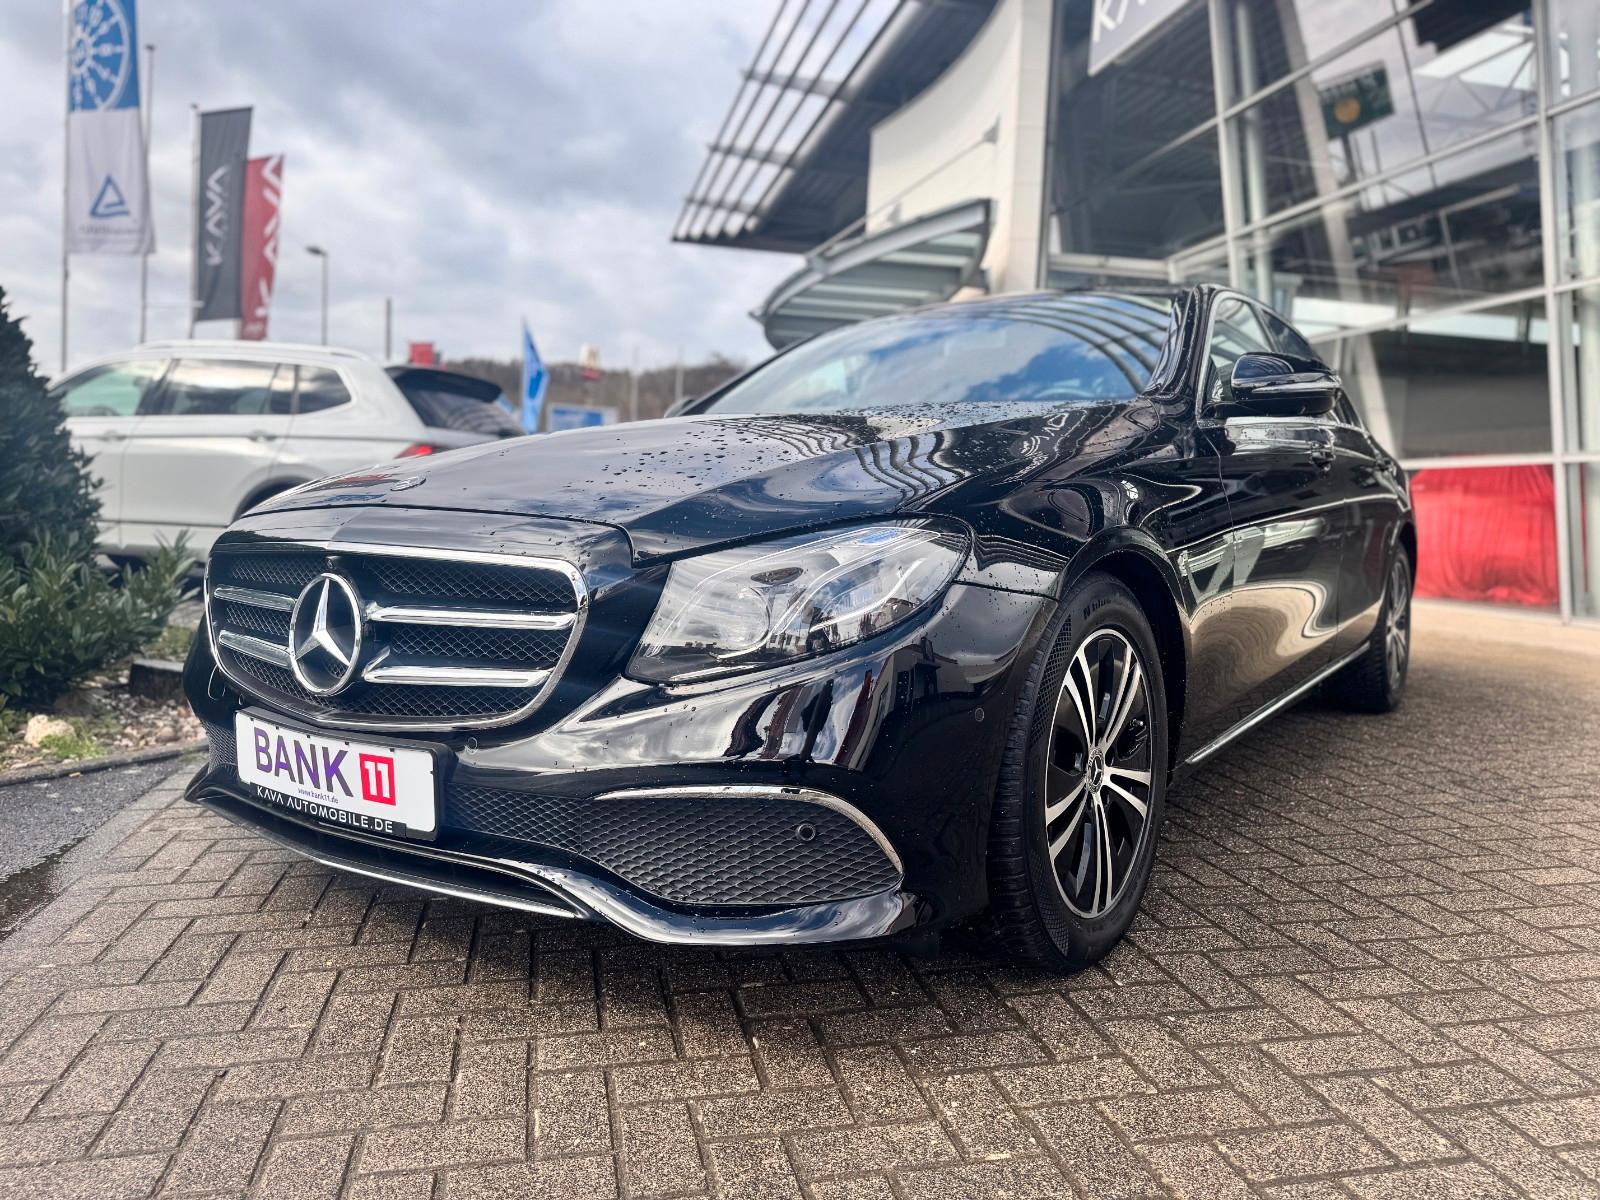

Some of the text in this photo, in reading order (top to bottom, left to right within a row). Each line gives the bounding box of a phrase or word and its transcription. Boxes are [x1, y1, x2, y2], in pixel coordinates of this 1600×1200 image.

[253, 726, 391, 799] BANK 11
[257, 785, 393, 833] KAVA AUTOMOBILE.DE
[298, 787, 339, 804] www.bank11.de
